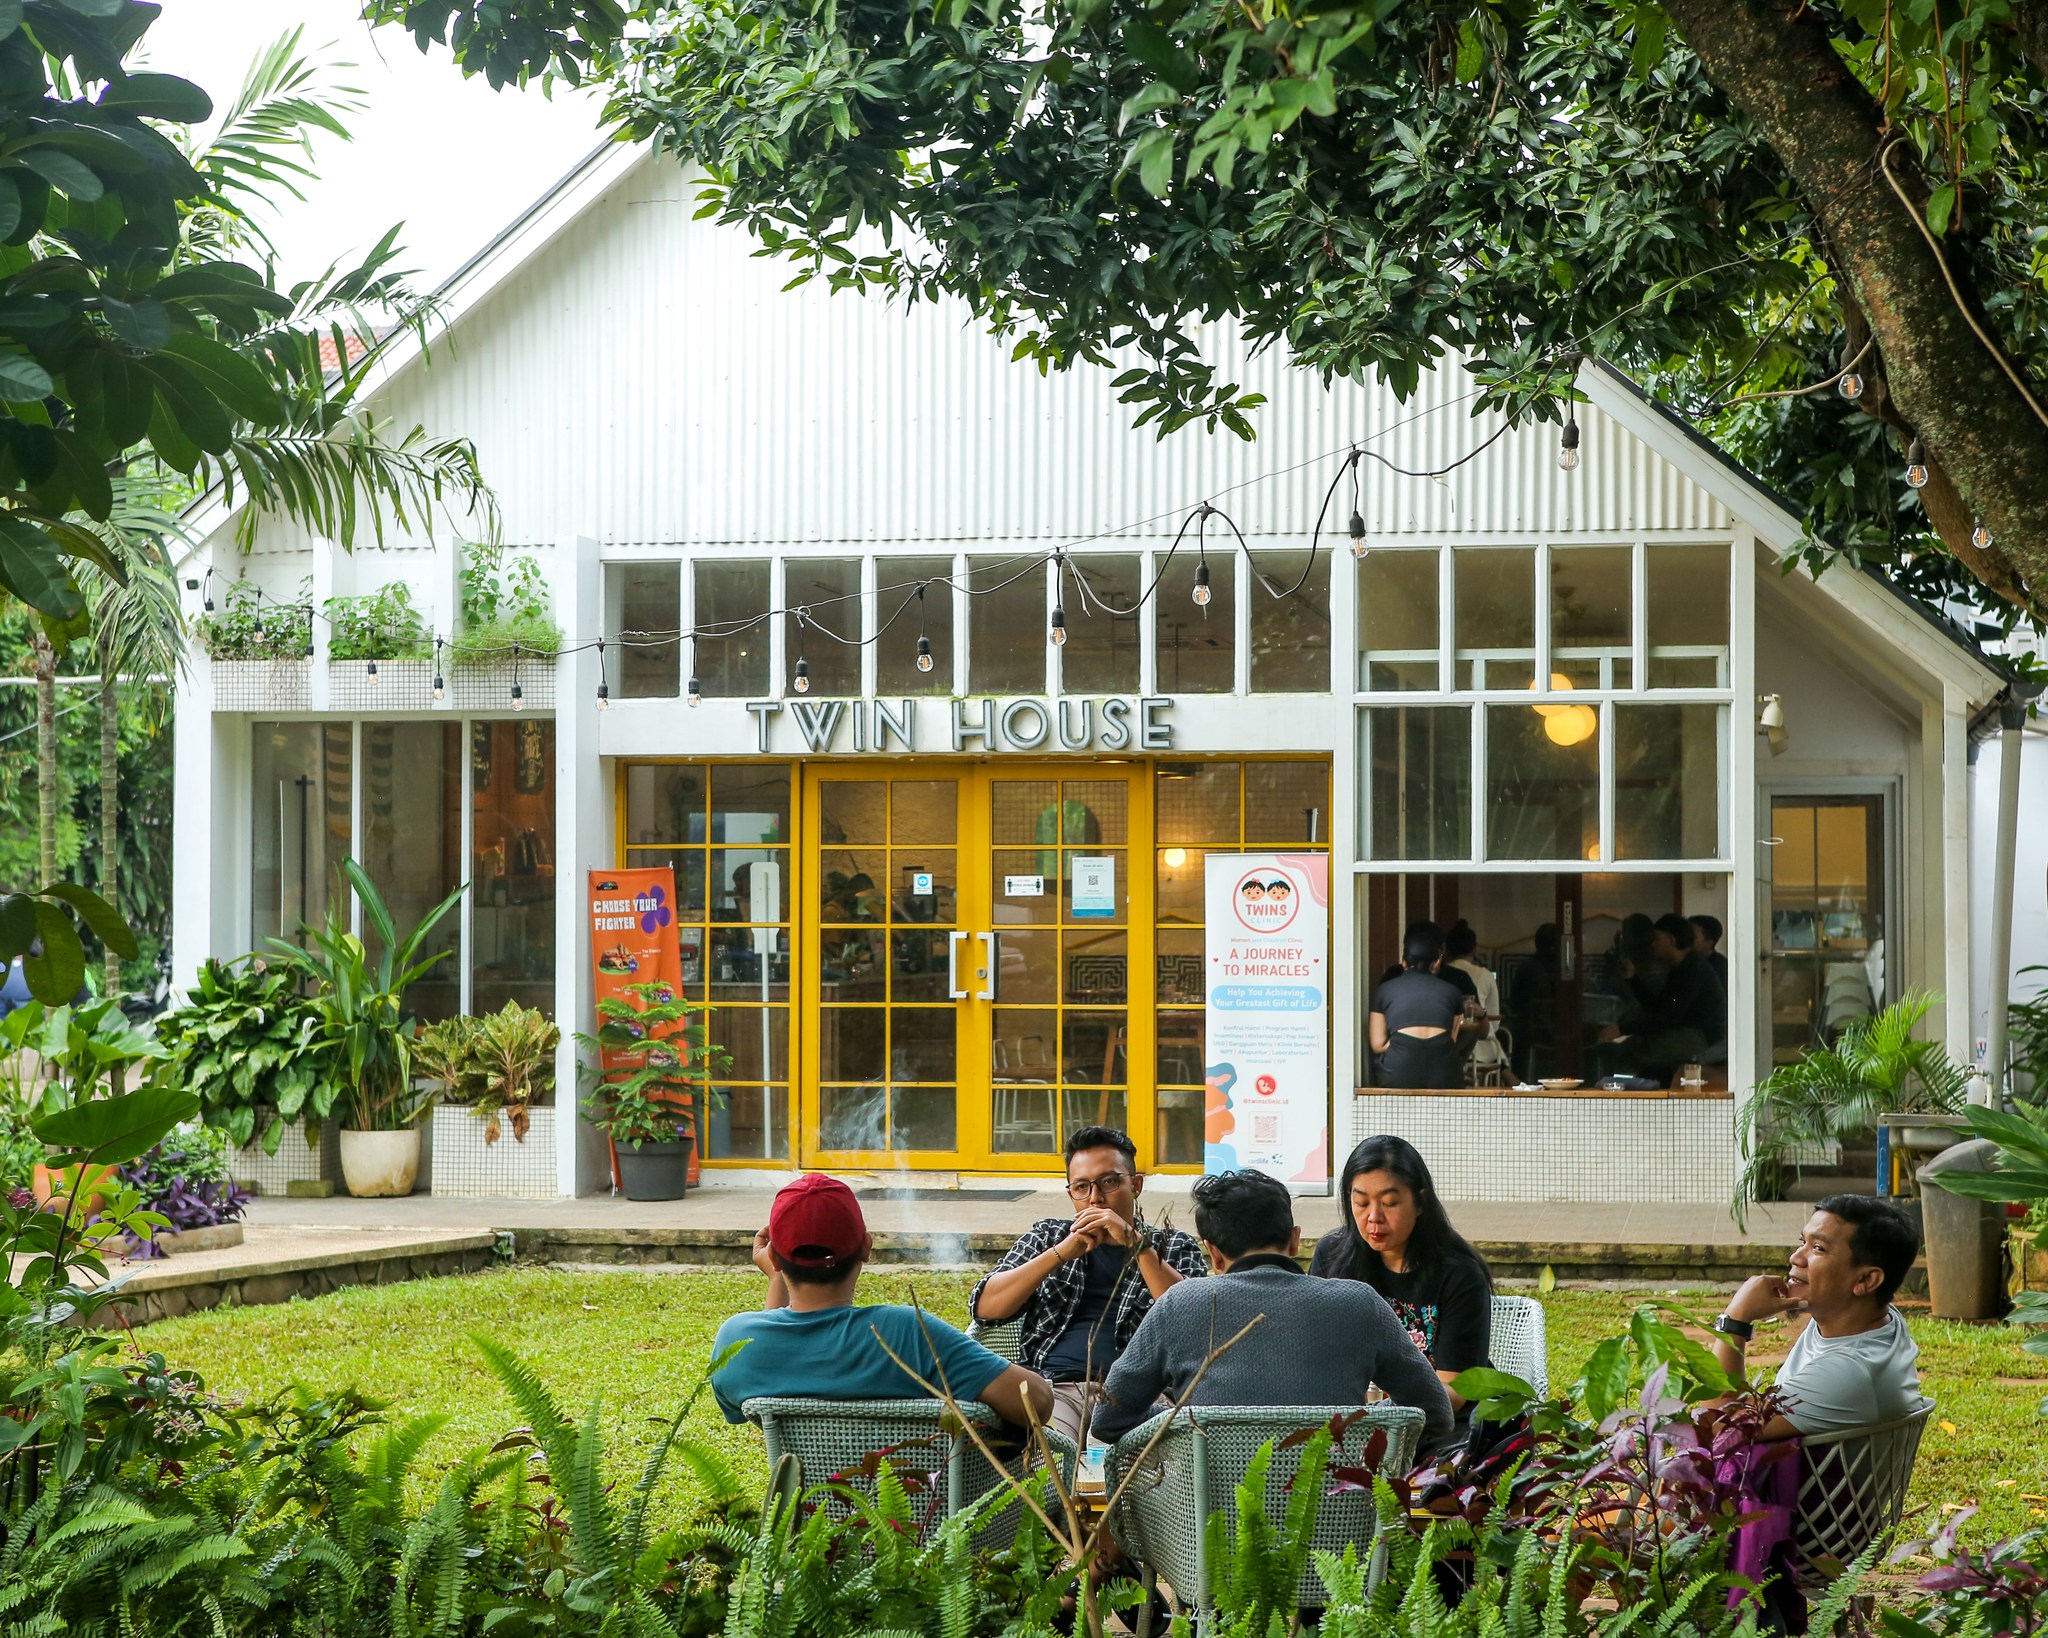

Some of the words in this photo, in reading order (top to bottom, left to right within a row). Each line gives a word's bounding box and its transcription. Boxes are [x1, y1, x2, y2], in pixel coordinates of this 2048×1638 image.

[746, 699, 917, 753] TWIN
[951, 697, 1175, 751] HOUSE
[593, 899, 630, 913] CHOOSE
[633, 898, 658, 912] YOUR
[1245, 904, 1287, 916] TWINS
[594, 916, 636, 931] FIGHTER
[1229, 948, 1239, 960] A
[1243, 948, 1303, 960] JOURNEY
[1223, 964, 1240, 976] TO
[1244, 964, 1310, 977] MIRACLES
[1227, 988, 1246, 998] Help
[1247, 988, 1263, 996] You
[1265, 988, 1305, 999] Achieving
[1215, 998, 1234, 1007] Your
[1235, 999, 1270, 1008] Greatest
[1272, 999, 1288, 1008] Gift
[1290, 999, 1299, 1008] of
[1301, 999, 1318, 1008] Life
